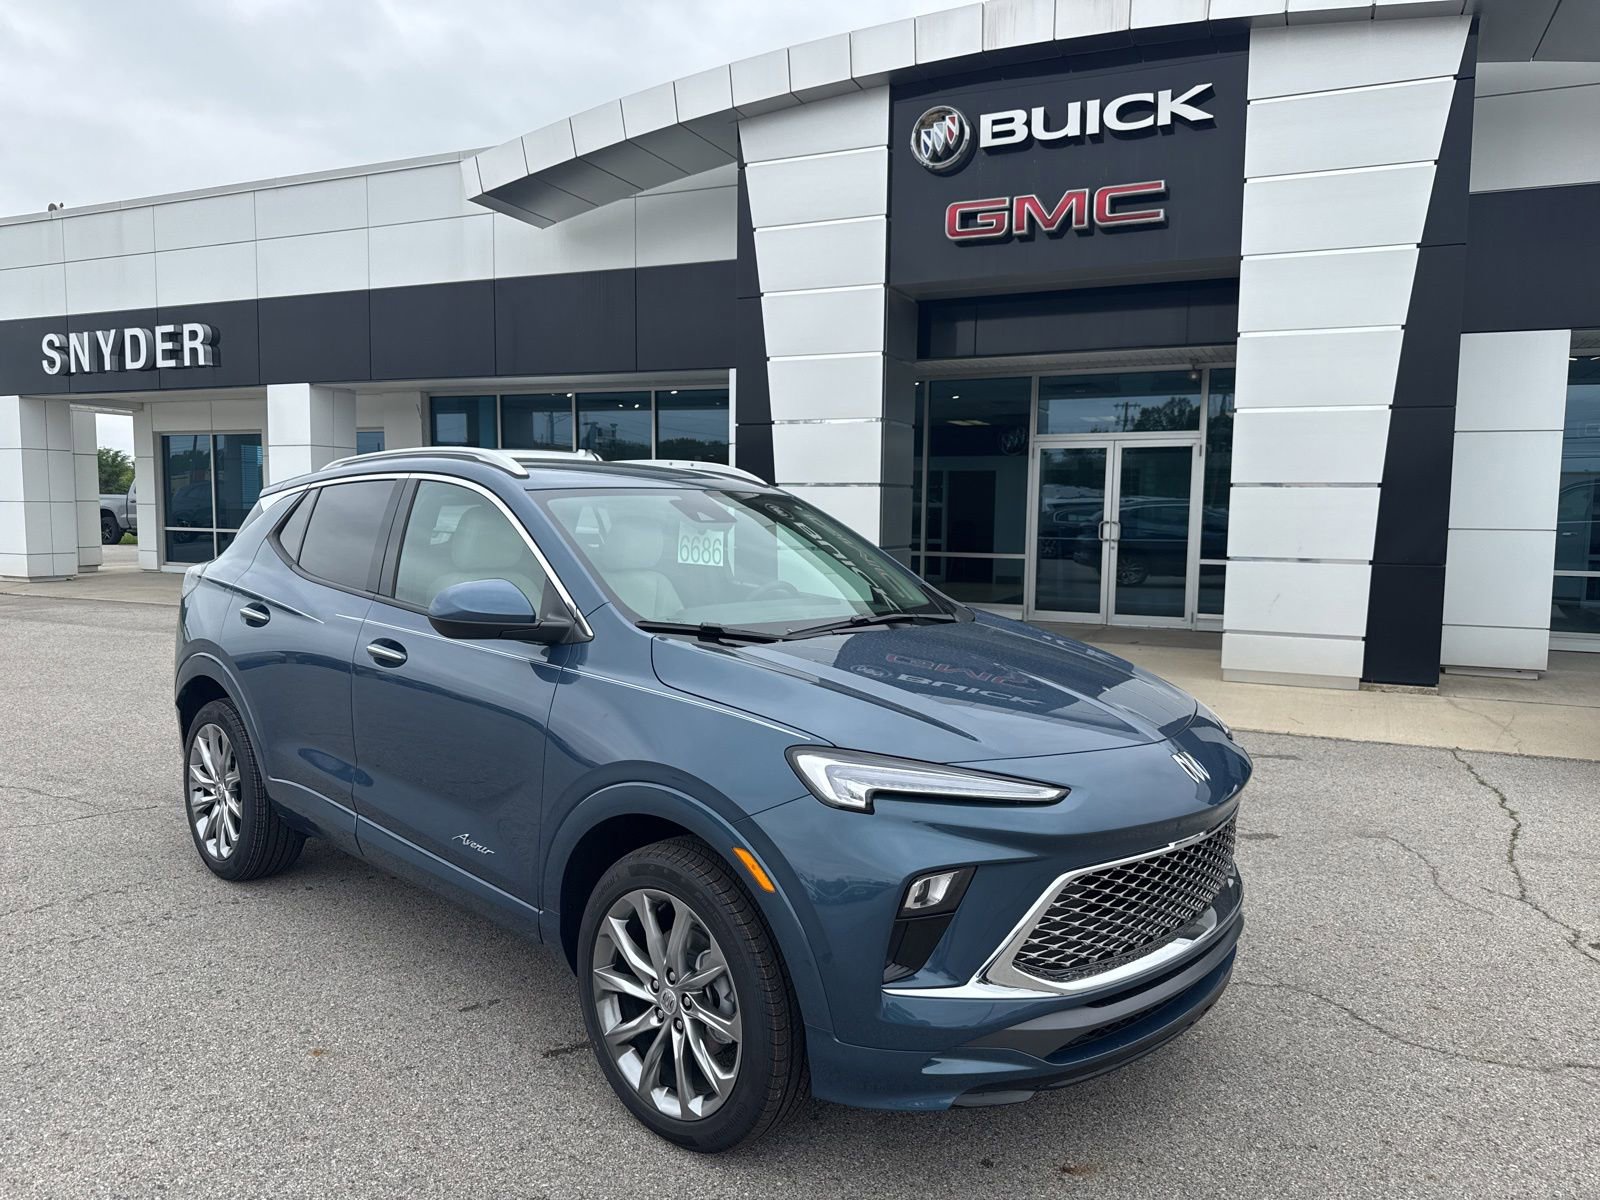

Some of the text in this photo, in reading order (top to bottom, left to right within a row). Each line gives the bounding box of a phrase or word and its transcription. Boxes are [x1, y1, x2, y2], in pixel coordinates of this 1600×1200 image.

[979, 82, 1215, 148] BUICK
[944, 179, 1167, 241] GMC
[41, 322, 211, 375] SNYDER
[679, 535, 722, 565] 6686
